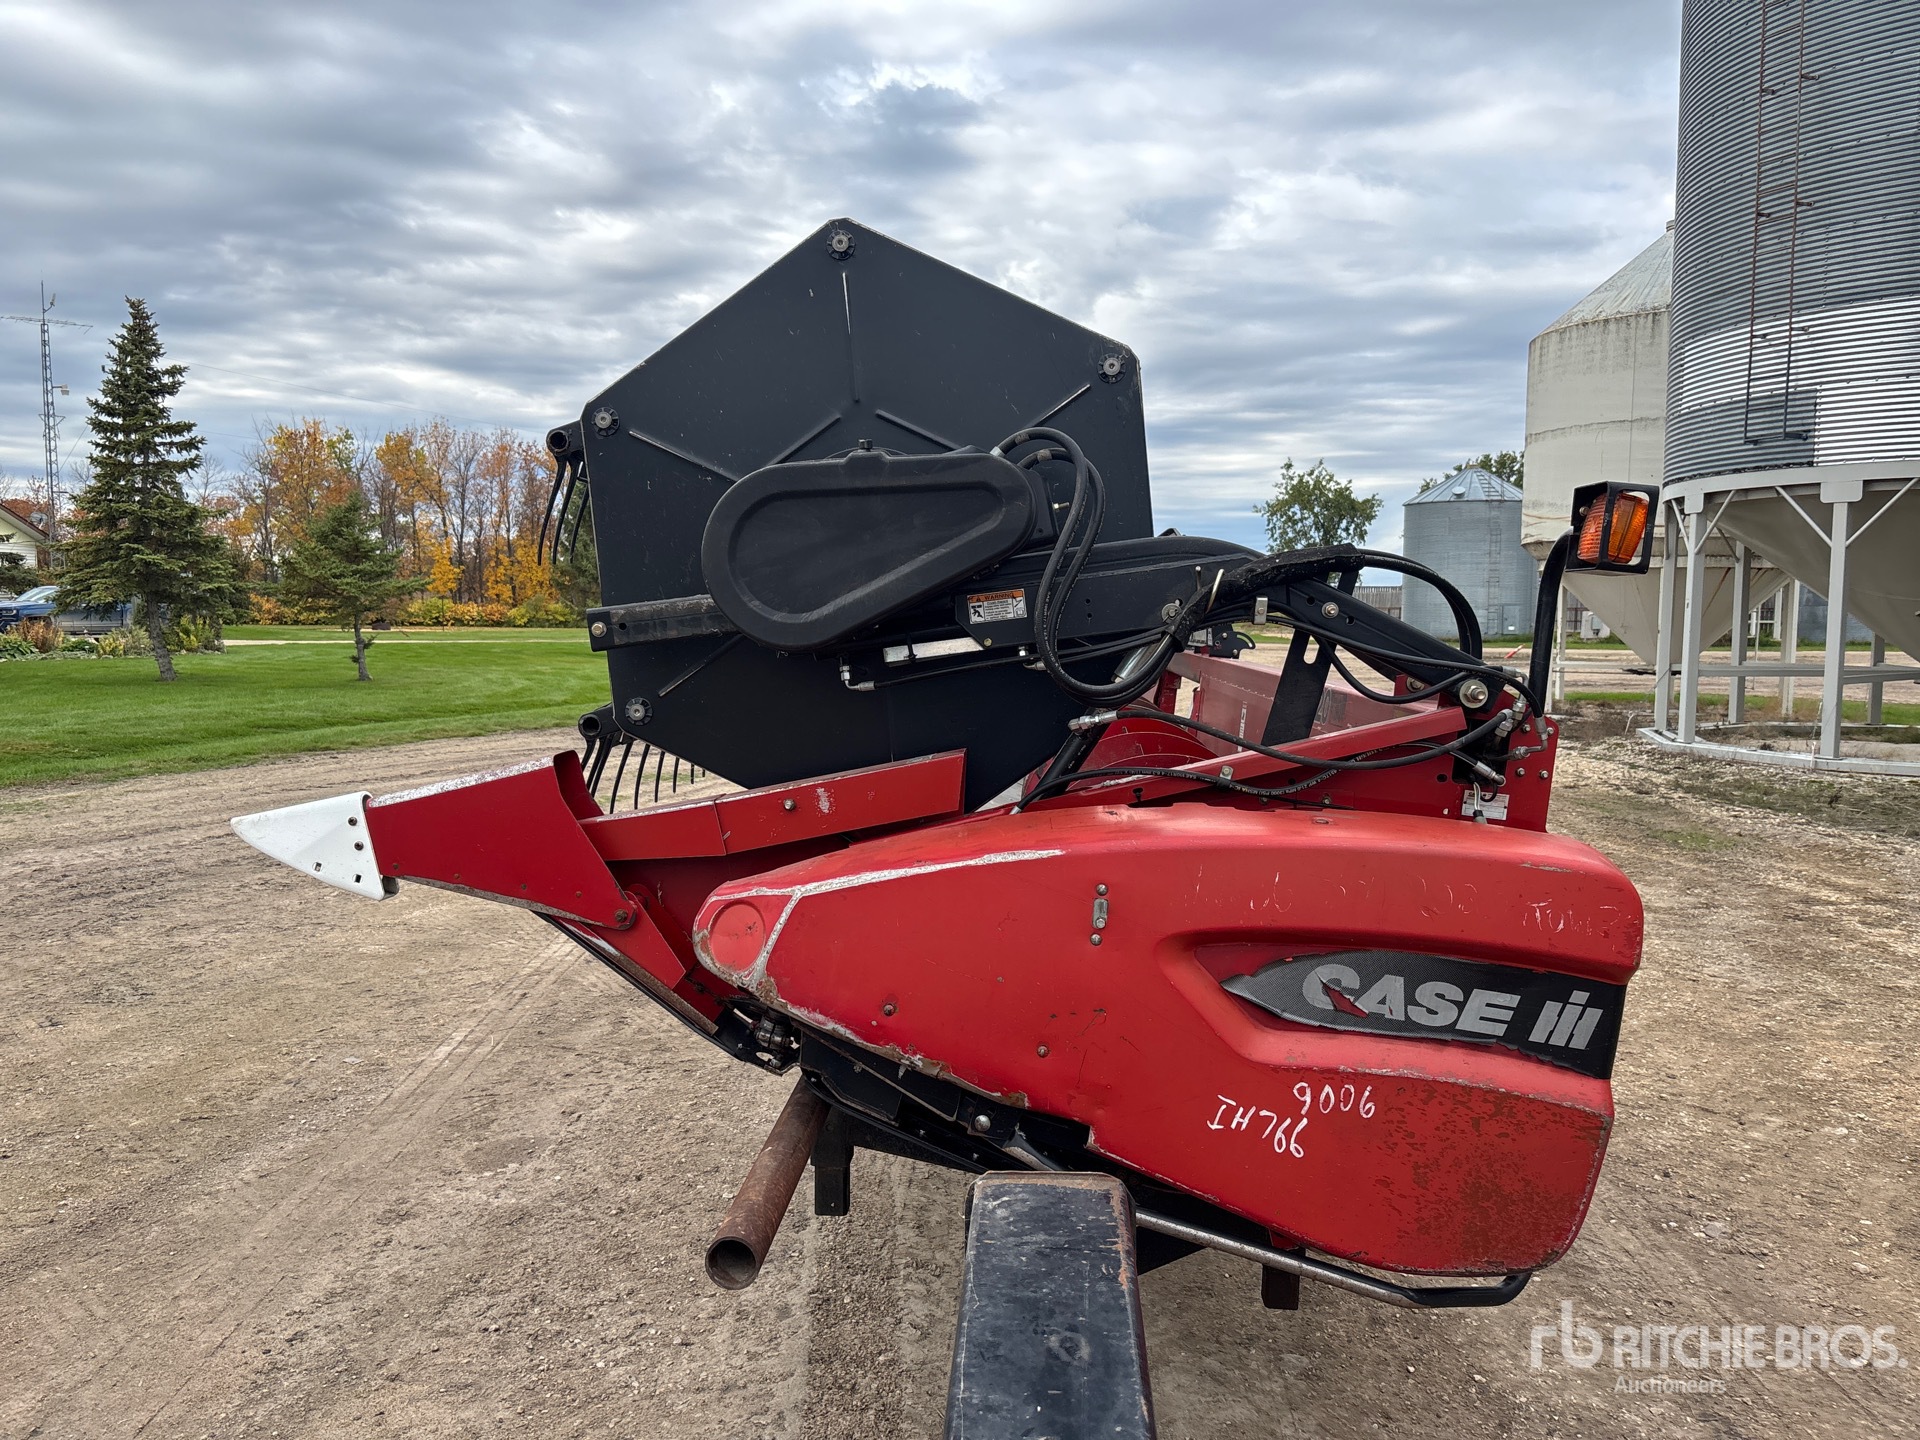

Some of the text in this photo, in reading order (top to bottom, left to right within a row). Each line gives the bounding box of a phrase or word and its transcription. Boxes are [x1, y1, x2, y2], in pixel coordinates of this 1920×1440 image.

[984, 592, 1013, 601] WARNING
[1302, 963, 1521, 1037] CASE
[1293, 1082, 1375, 1119] 9006
